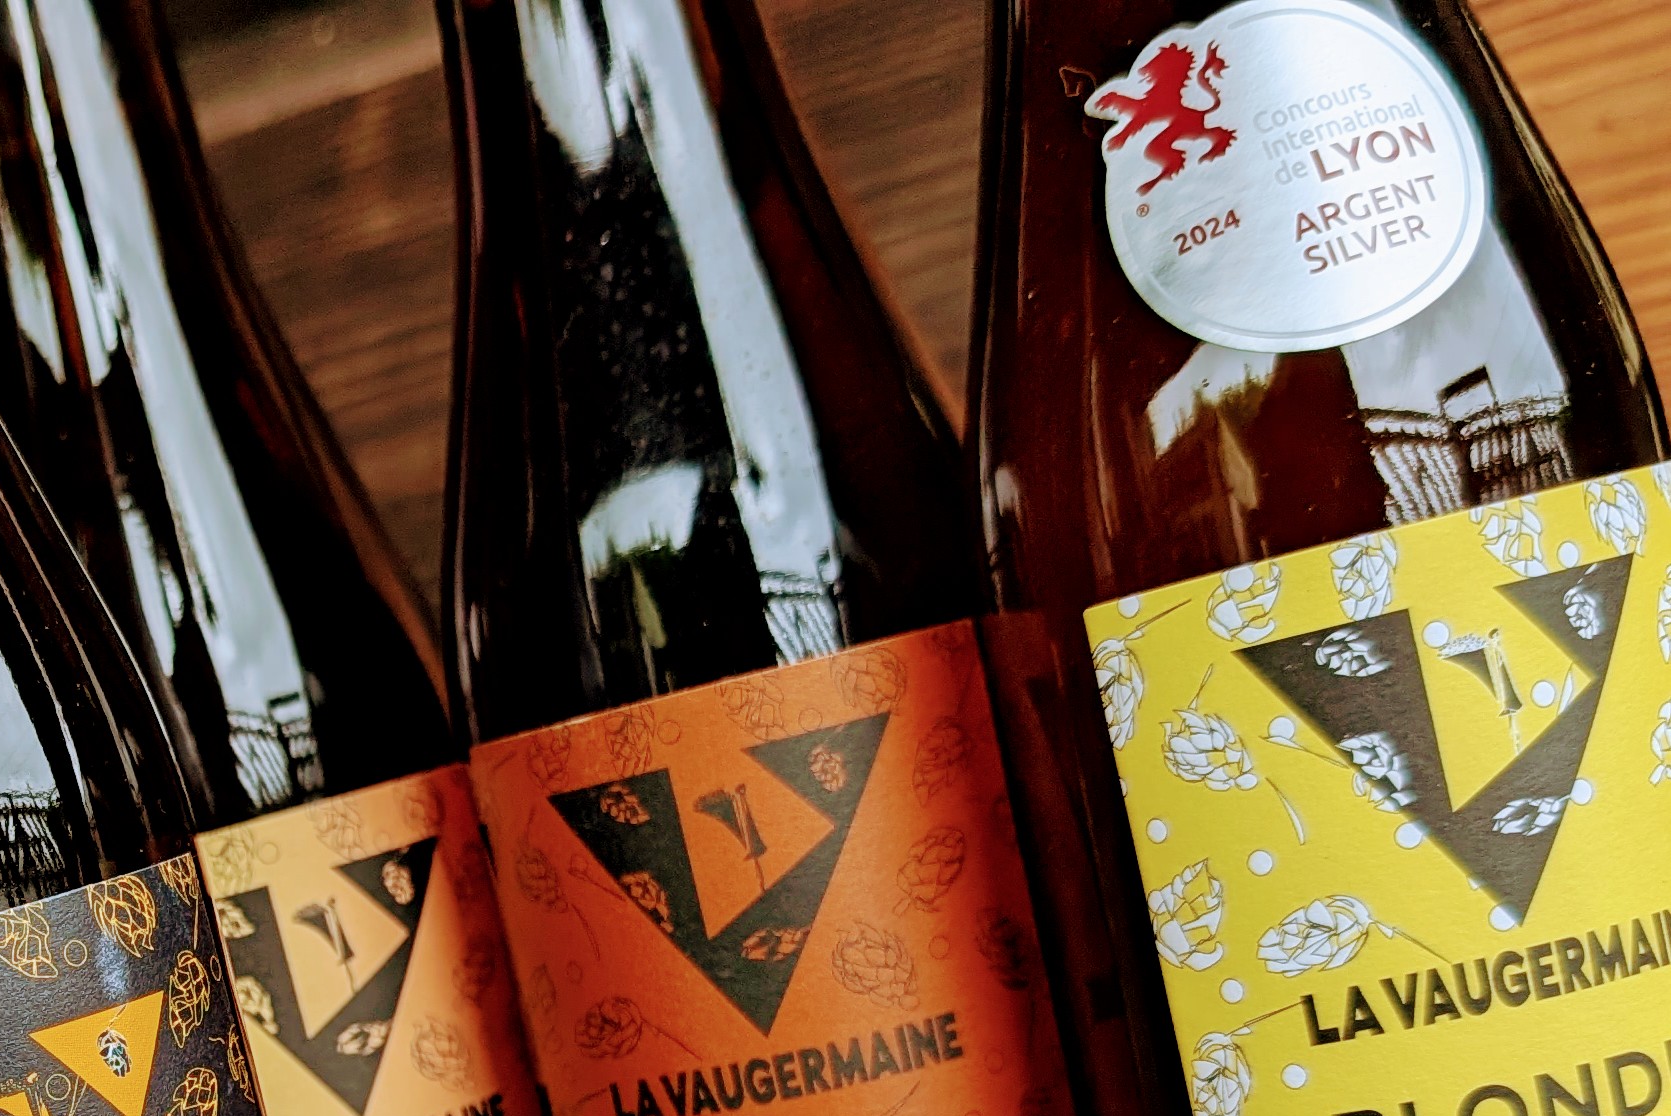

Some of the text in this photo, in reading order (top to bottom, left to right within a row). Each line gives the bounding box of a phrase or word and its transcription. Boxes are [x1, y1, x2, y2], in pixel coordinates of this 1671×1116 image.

[1253, 82, 1372, 134] Concours
[1262, 94, 1424, 160] International
[1275, 122, 1436, 186] de LYON
[1173, 208, 1240, 256] 2024
[1294, 174, 1438, 242] ARGENT
[1303, 214, 1431, 275] SILVER
[1300, 984, 1384, 1047] LA
